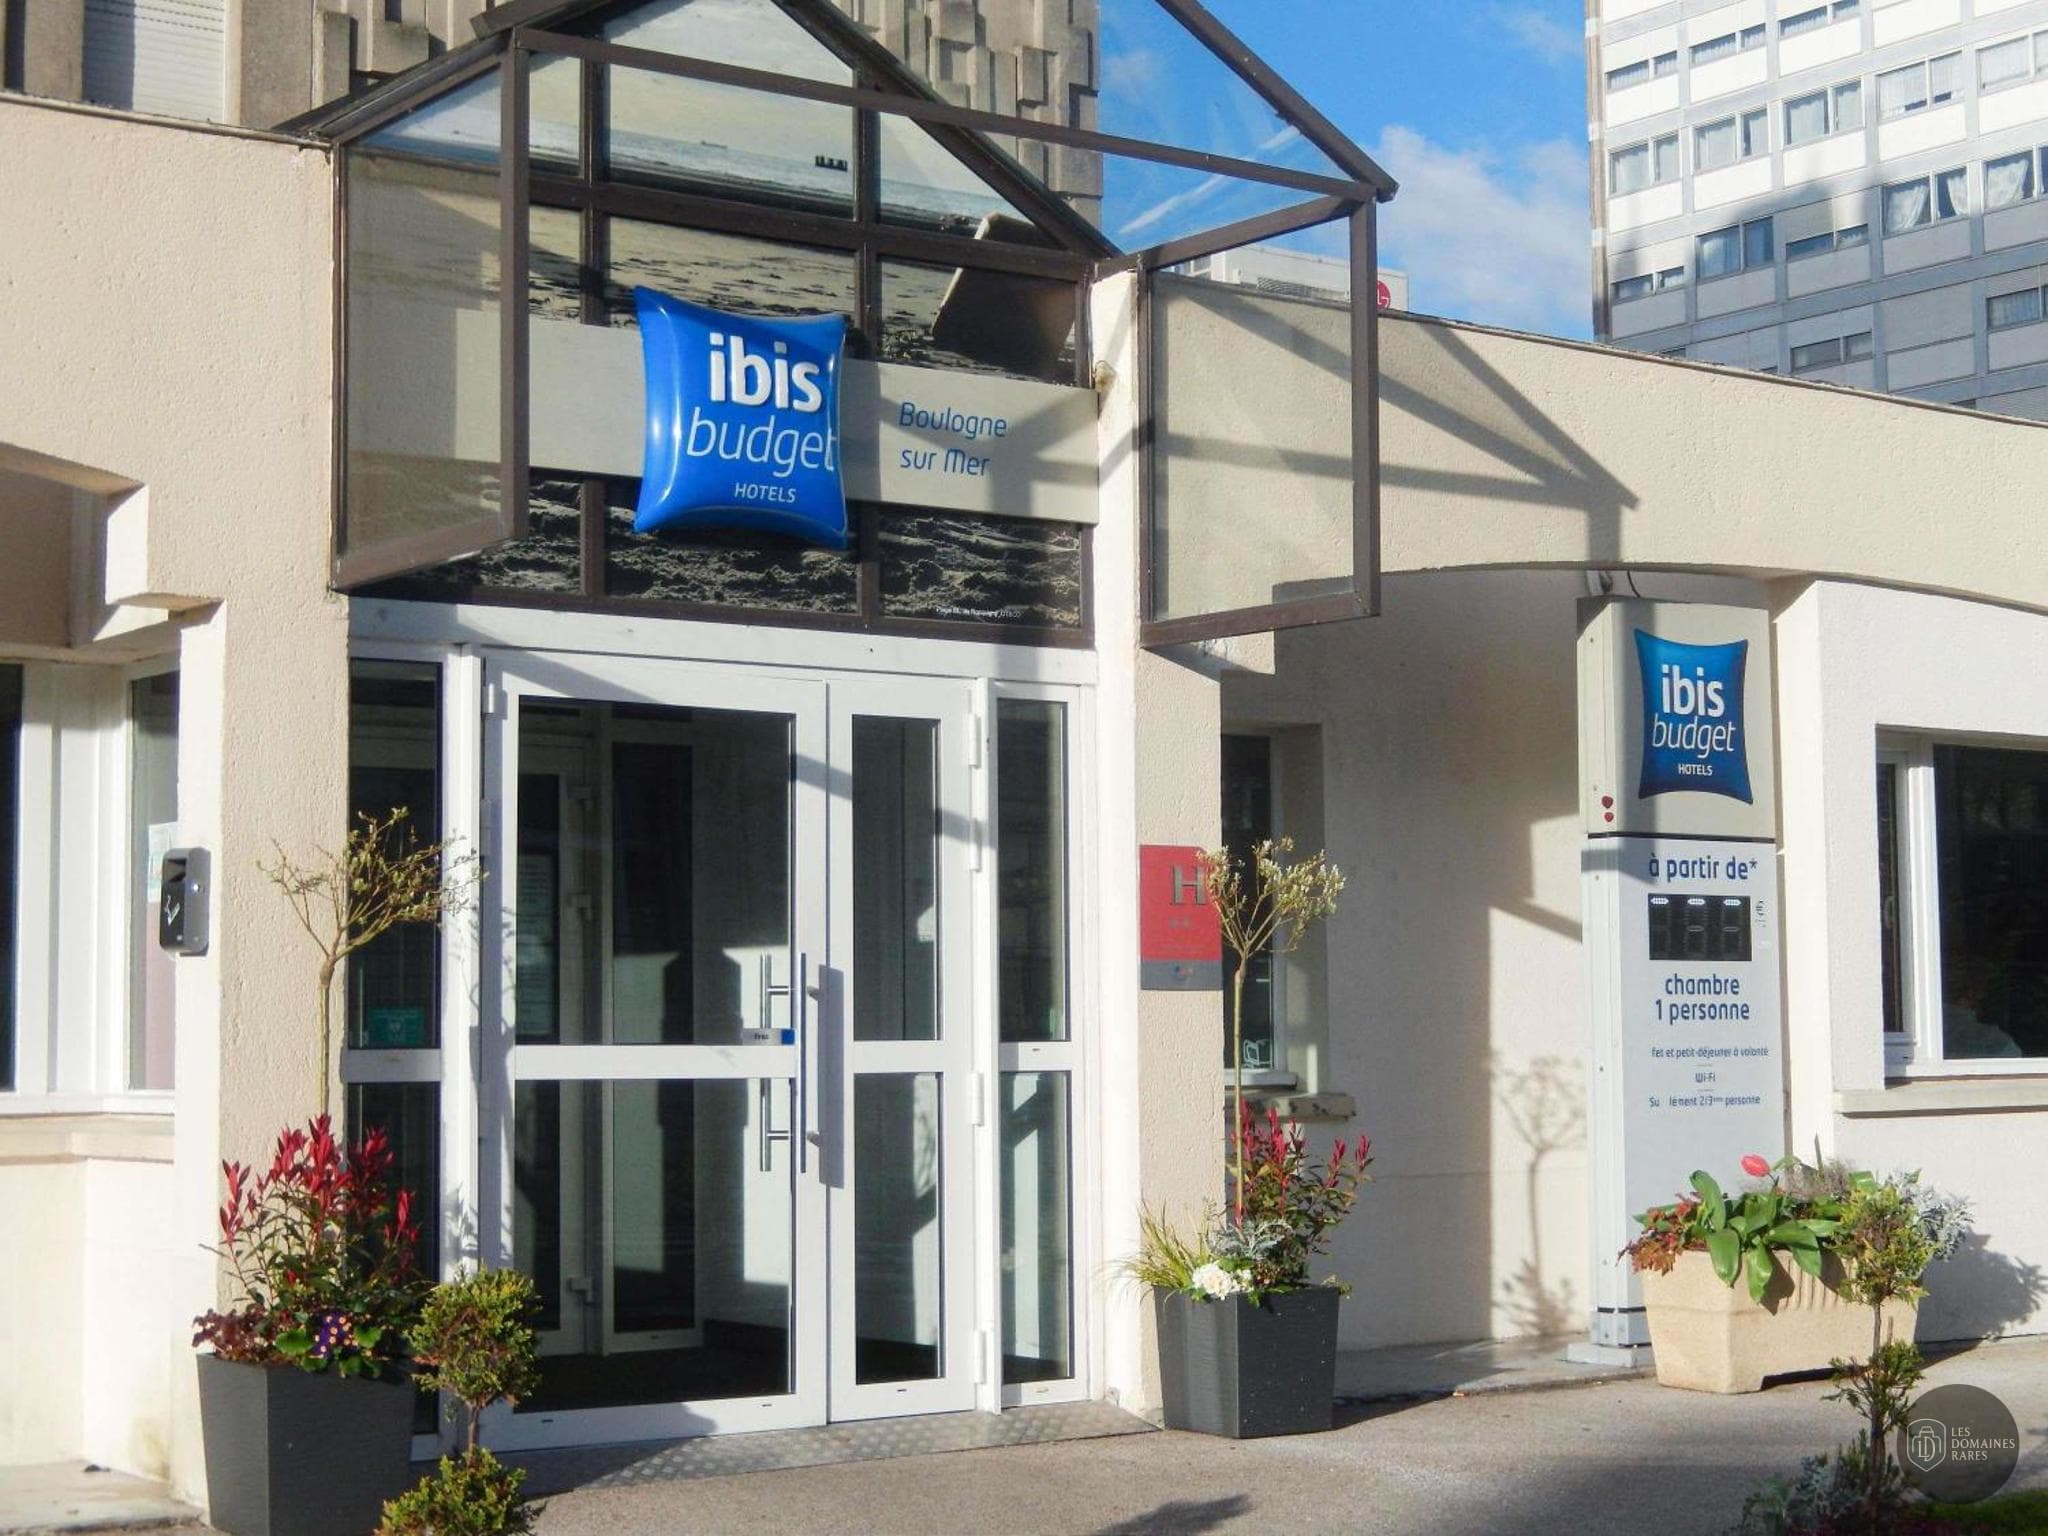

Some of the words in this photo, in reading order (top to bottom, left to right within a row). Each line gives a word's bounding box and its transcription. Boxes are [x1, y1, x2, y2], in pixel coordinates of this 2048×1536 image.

[709, 332, 823, 413] ibis
[900, 402, 1008, 440] Boulogne
[687, 407, 836, 478] budget
[900, 448, 936, 473] sur
[944, 449, 991, 477] Mer
[734, 483, 796, 504] HOTELS
[1661, 664, 1725, 717] ibis
[1652, 713, 1736, 759] budget
[1678, 763, 1713, 776] HOTELS
[1649, 852, 1659, 877] à
[1667, 855, 1719, 882] partir
[1172, 865, 1205, 905] H
[1665, 973, 1740, 996] chambre
[1656, 1000, 1663, 1020] 1
[1670, 1003, 1750, 1025] personne
[1695, 1072, 1716, 1083] Wi-Fi
